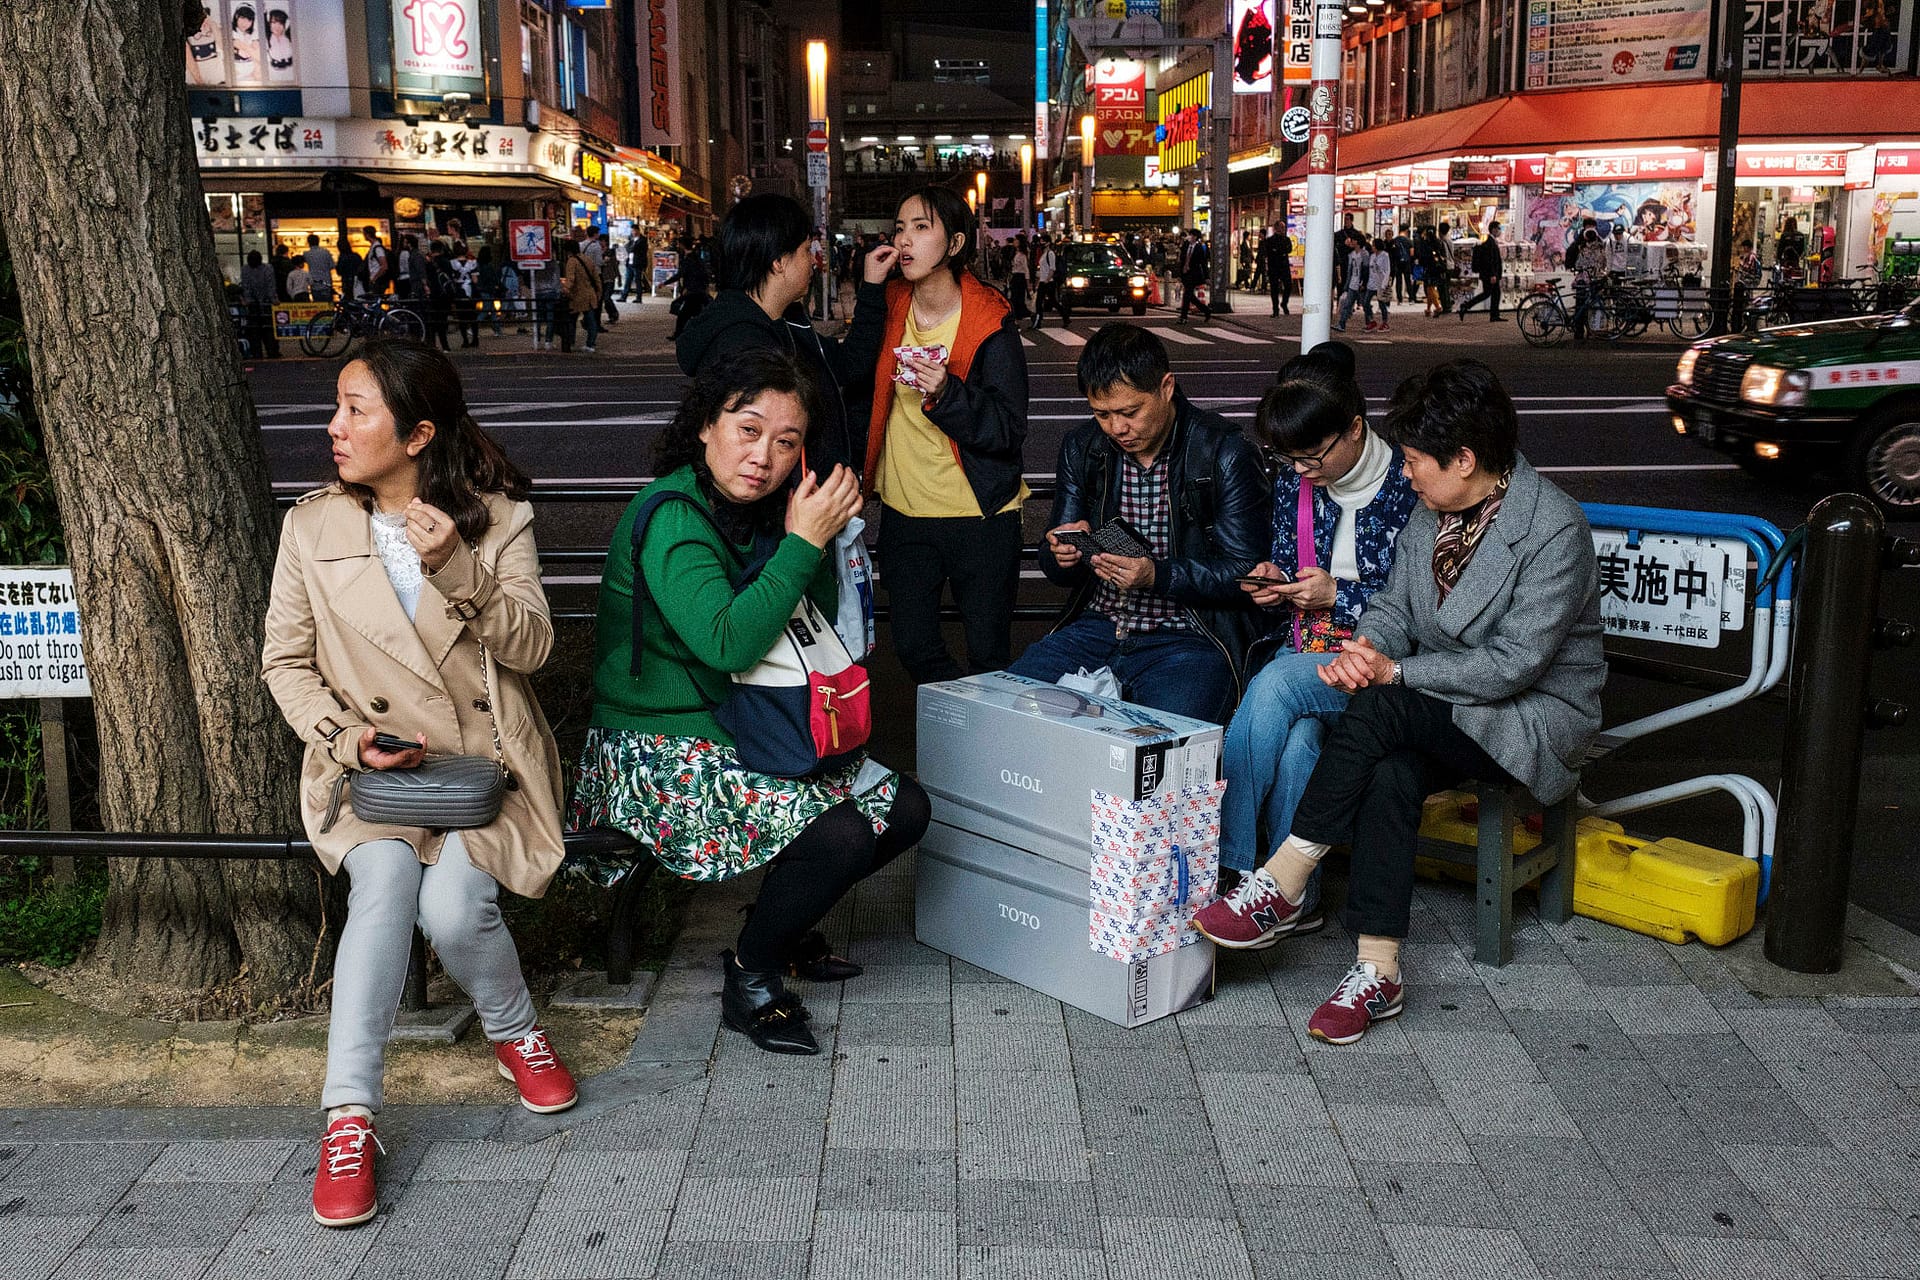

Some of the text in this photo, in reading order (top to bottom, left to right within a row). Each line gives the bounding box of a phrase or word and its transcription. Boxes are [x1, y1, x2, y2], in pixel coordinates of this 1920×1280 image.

[1101, 88, 1139, 101] アコム
[1098, 110, 1133, 120] 3F 入口
[198, 122, 298, 151] 富士そば
[303, 129, 322, 141] 24
[499, 137, 513, 148] 24
[303, 141, 323, 150] 時間
[1597, 552, 1708, 609] 実施中
[0, 611, 81, 636] 在此乱扔烟
[17, 639, 41, 659] not
[28, 665, 43, 680] or
[1001, 769, 1043, 794] TOTO
[998, 903, 1041, 930] TOTO
